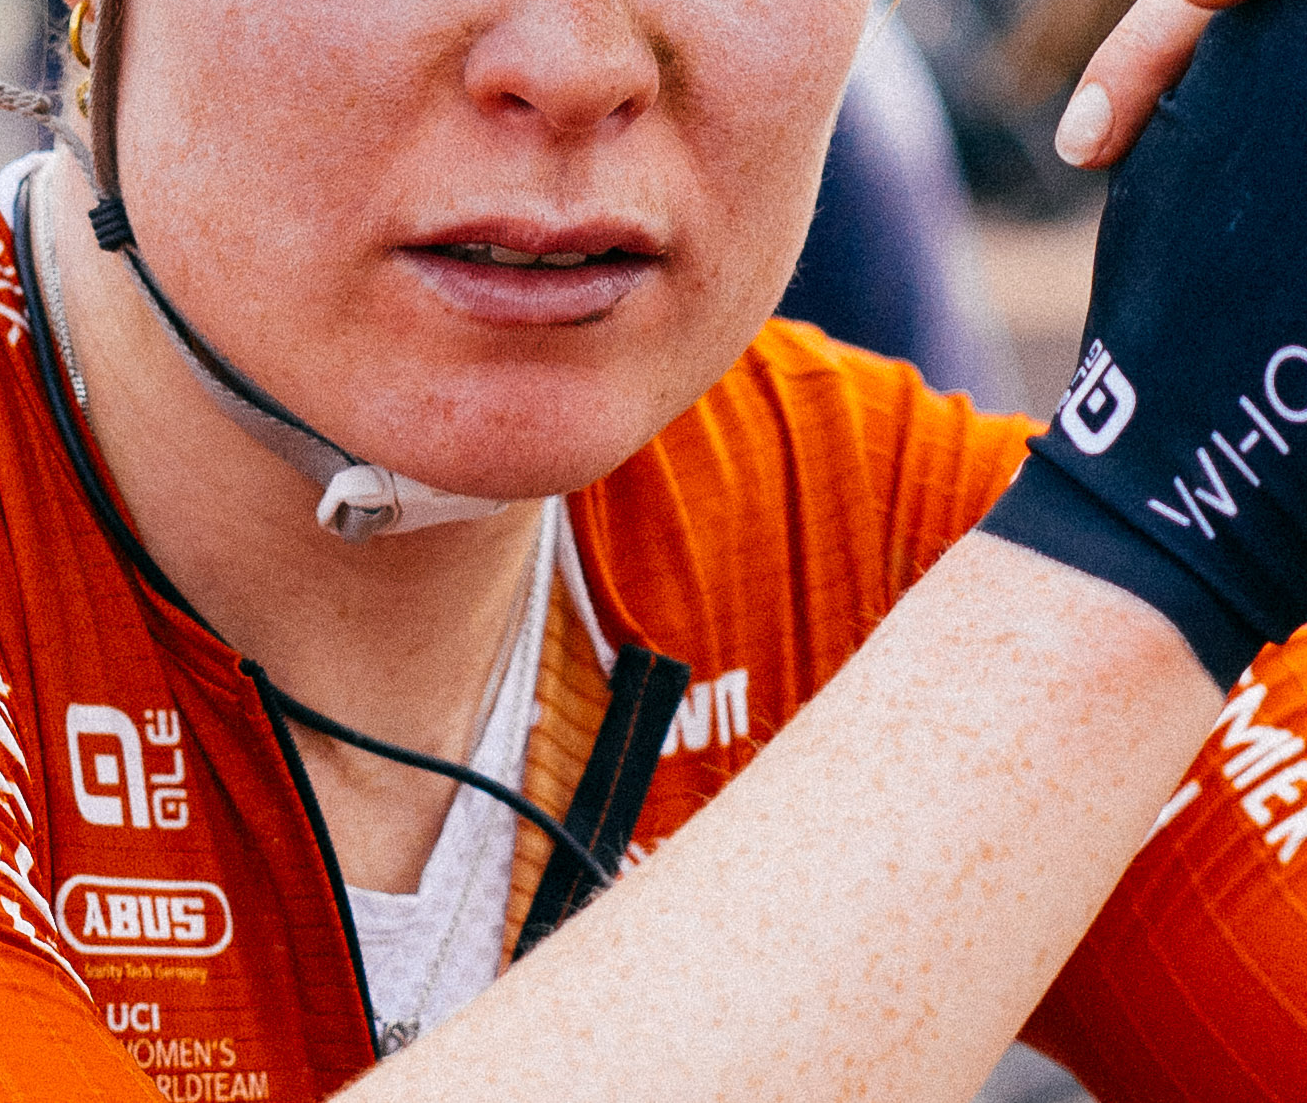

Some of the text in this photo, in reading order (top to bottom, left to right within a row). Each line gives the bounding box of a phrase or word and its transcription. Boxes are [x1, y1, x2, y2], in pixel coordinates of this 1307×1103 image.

[82, 891, 207, 941] ABUS
[106, 1002, 161, 1032] UCI
[123, 1037, 236, 1069] OMEN'S
[155, 1071, 270, 1103] RLDTEAM
